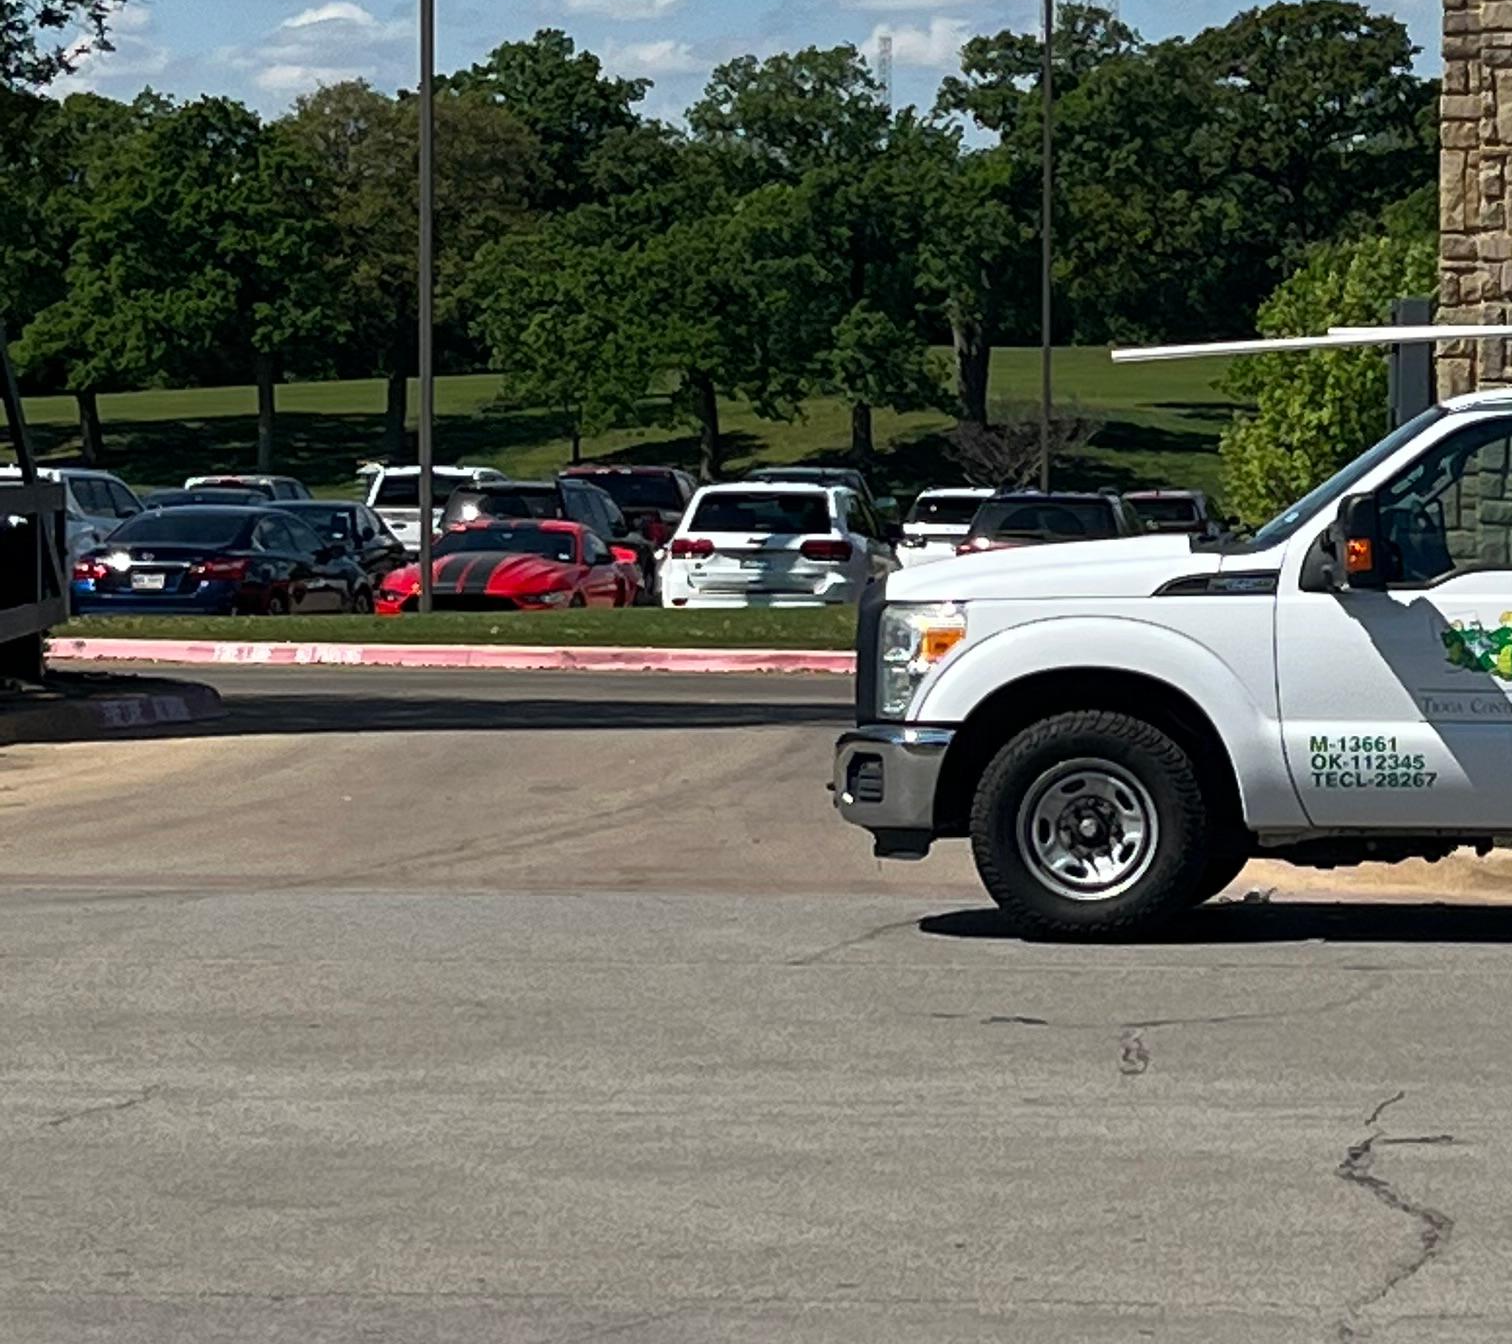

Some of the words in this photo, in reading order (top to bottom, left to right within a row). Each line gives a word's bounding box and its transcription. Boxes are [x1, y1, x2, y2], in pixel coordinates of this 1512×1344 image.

[1310, 736, 1397, 752] M-13661
[1311, 754, 1425, 770] OK-112345
[1312, 772, 1437, 788] TECL-28267
